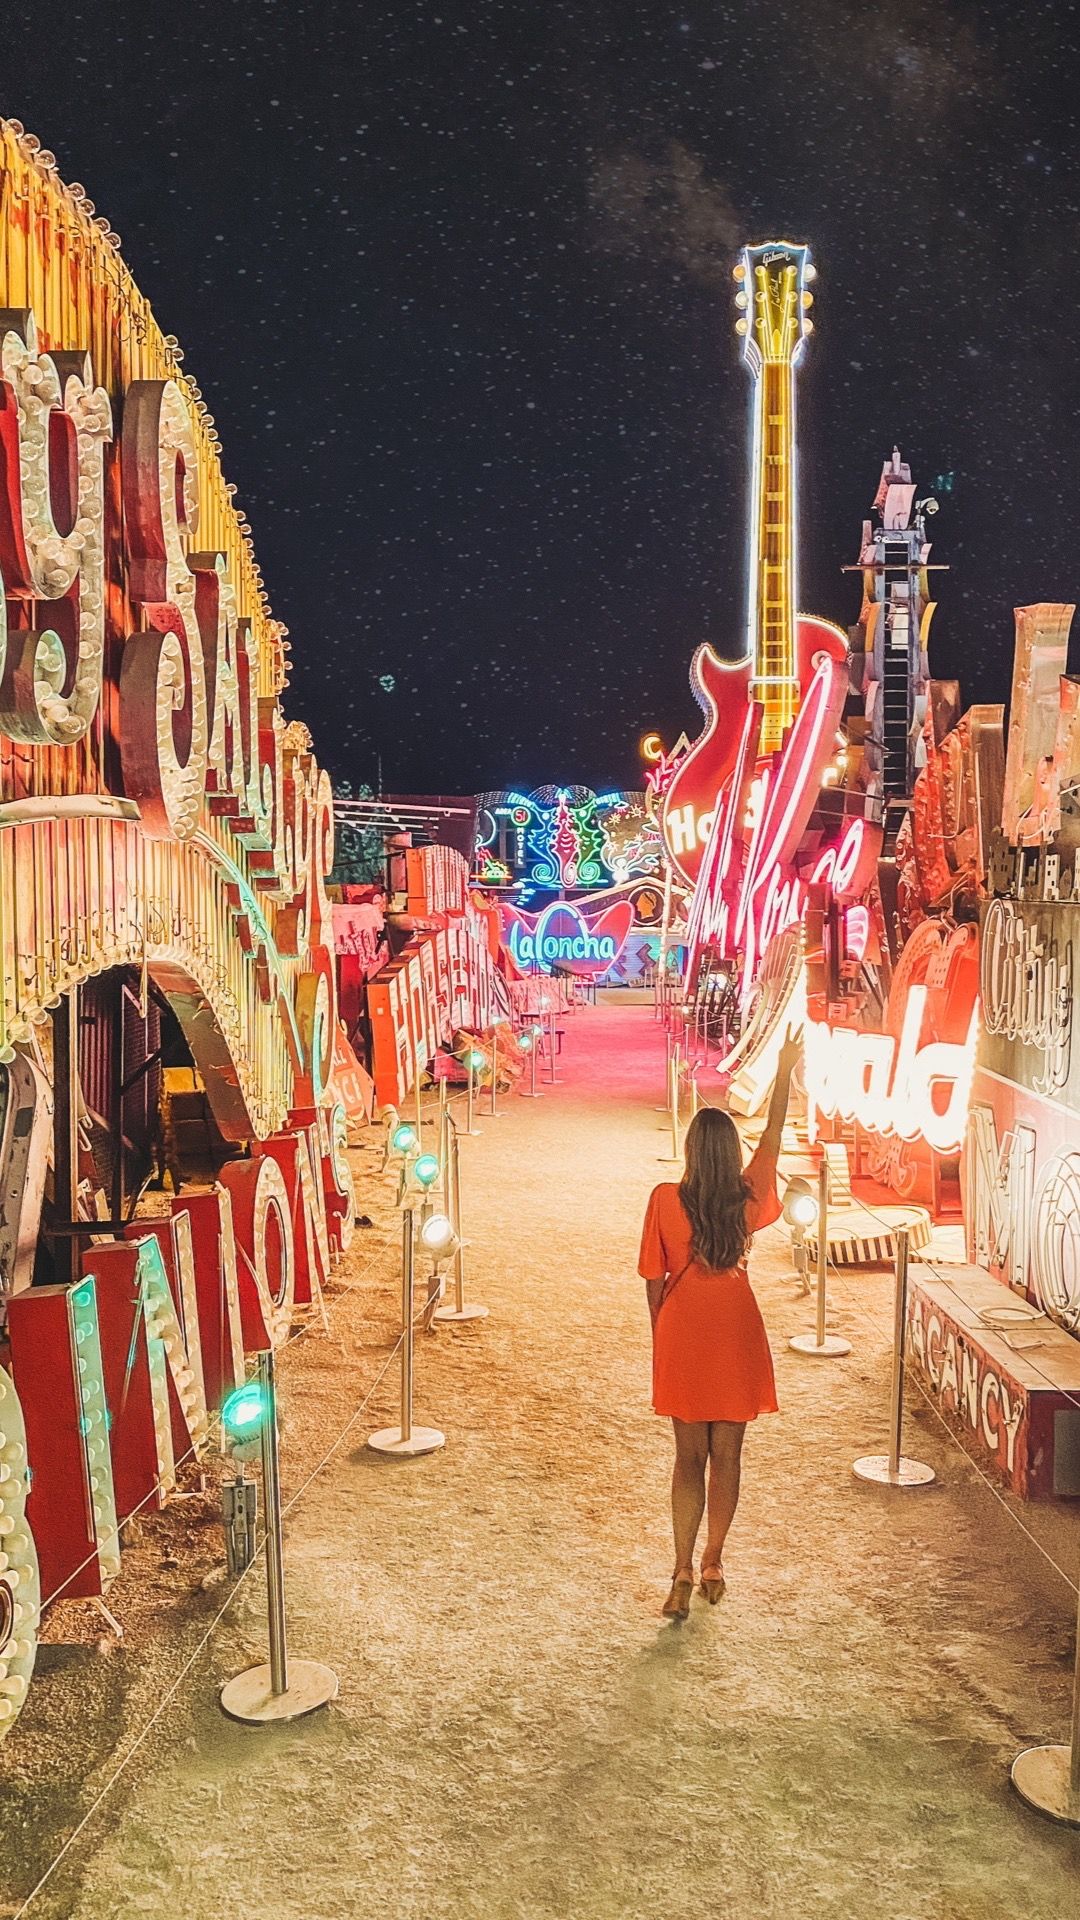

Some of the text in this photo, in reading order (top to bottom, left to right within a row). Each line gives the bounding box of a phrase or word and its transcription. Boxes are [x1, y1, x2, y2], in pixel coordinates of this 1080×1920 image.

[515, 809, 526, 822] 51
[516, 827, 525, 865] MOTEL
[536, 901, 616, 973] Concha
[905, 1291, 1024, 1474] ACANCY
